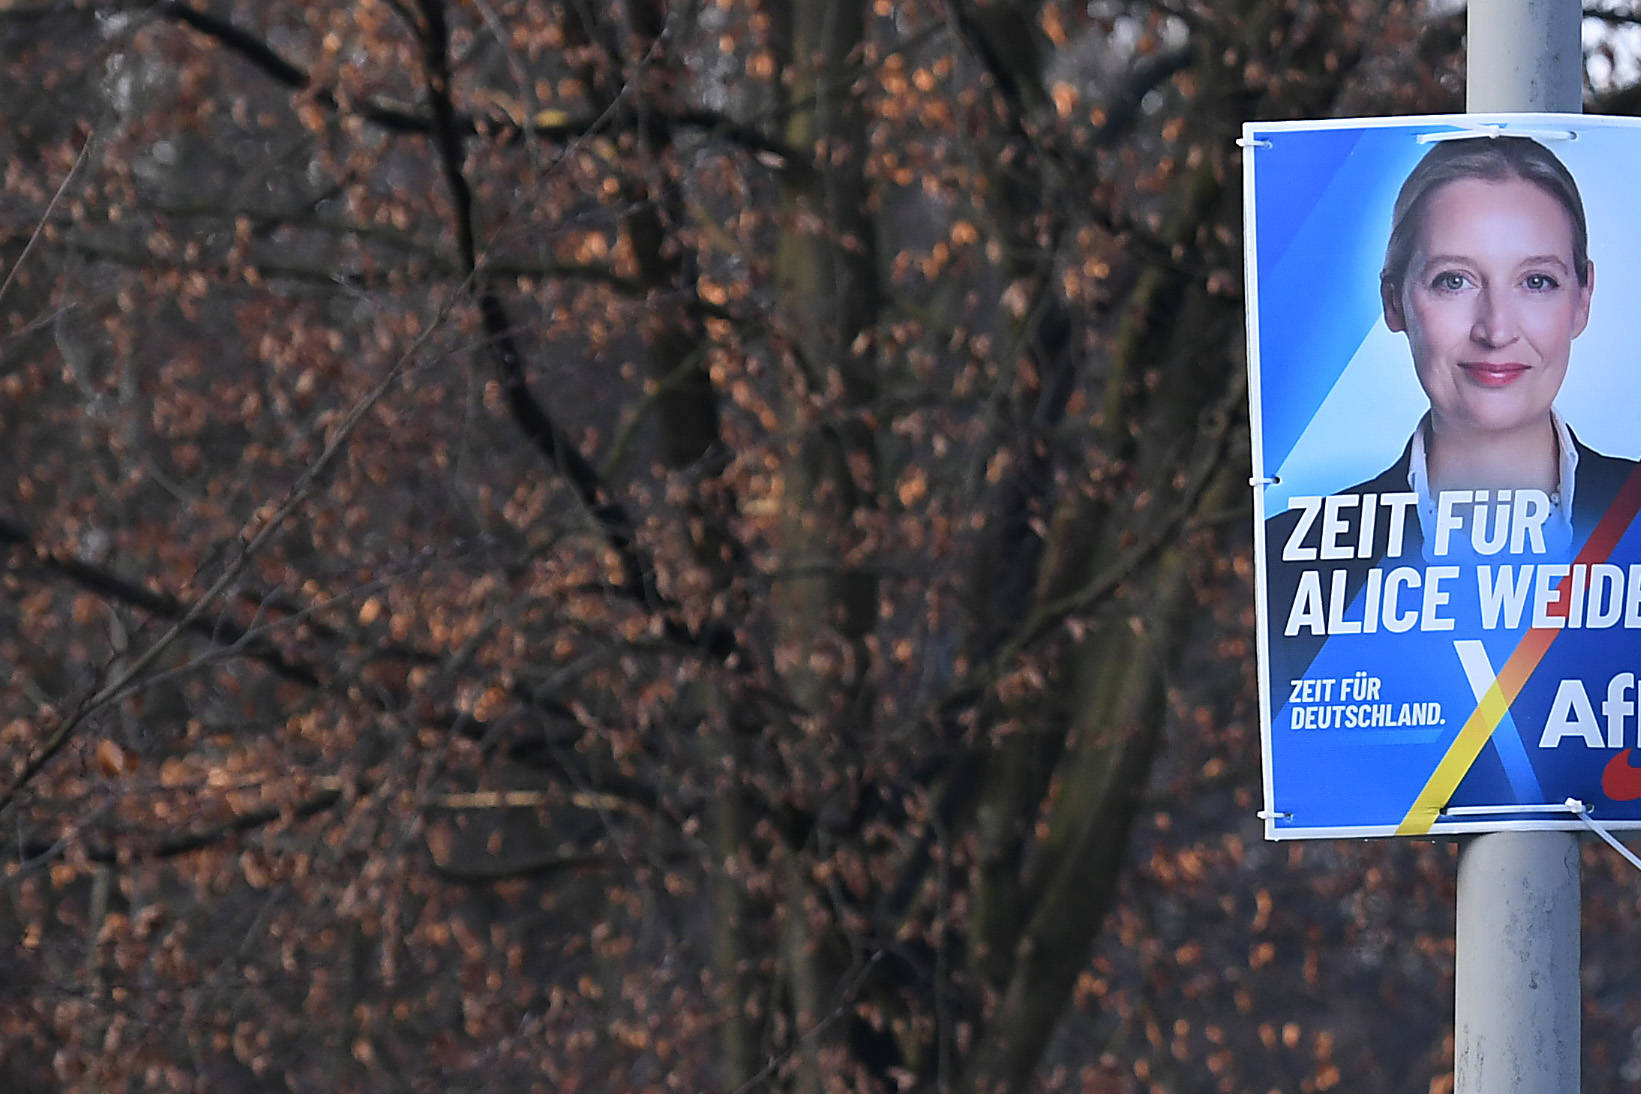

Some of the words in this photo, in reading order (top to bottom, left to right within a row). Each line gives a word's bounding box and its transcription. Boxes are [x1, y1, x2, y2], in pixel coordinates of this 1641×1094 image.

[1283, 492, 1418, 561] ZEIT
[1284, 566, 1459, 636] ALICE
[1289, 678, 1335, 702] ZEIT
[1340, 672, 1381, 700] FÜR
[1290, 703, 1446, 730] DEUTSCHLAND.
